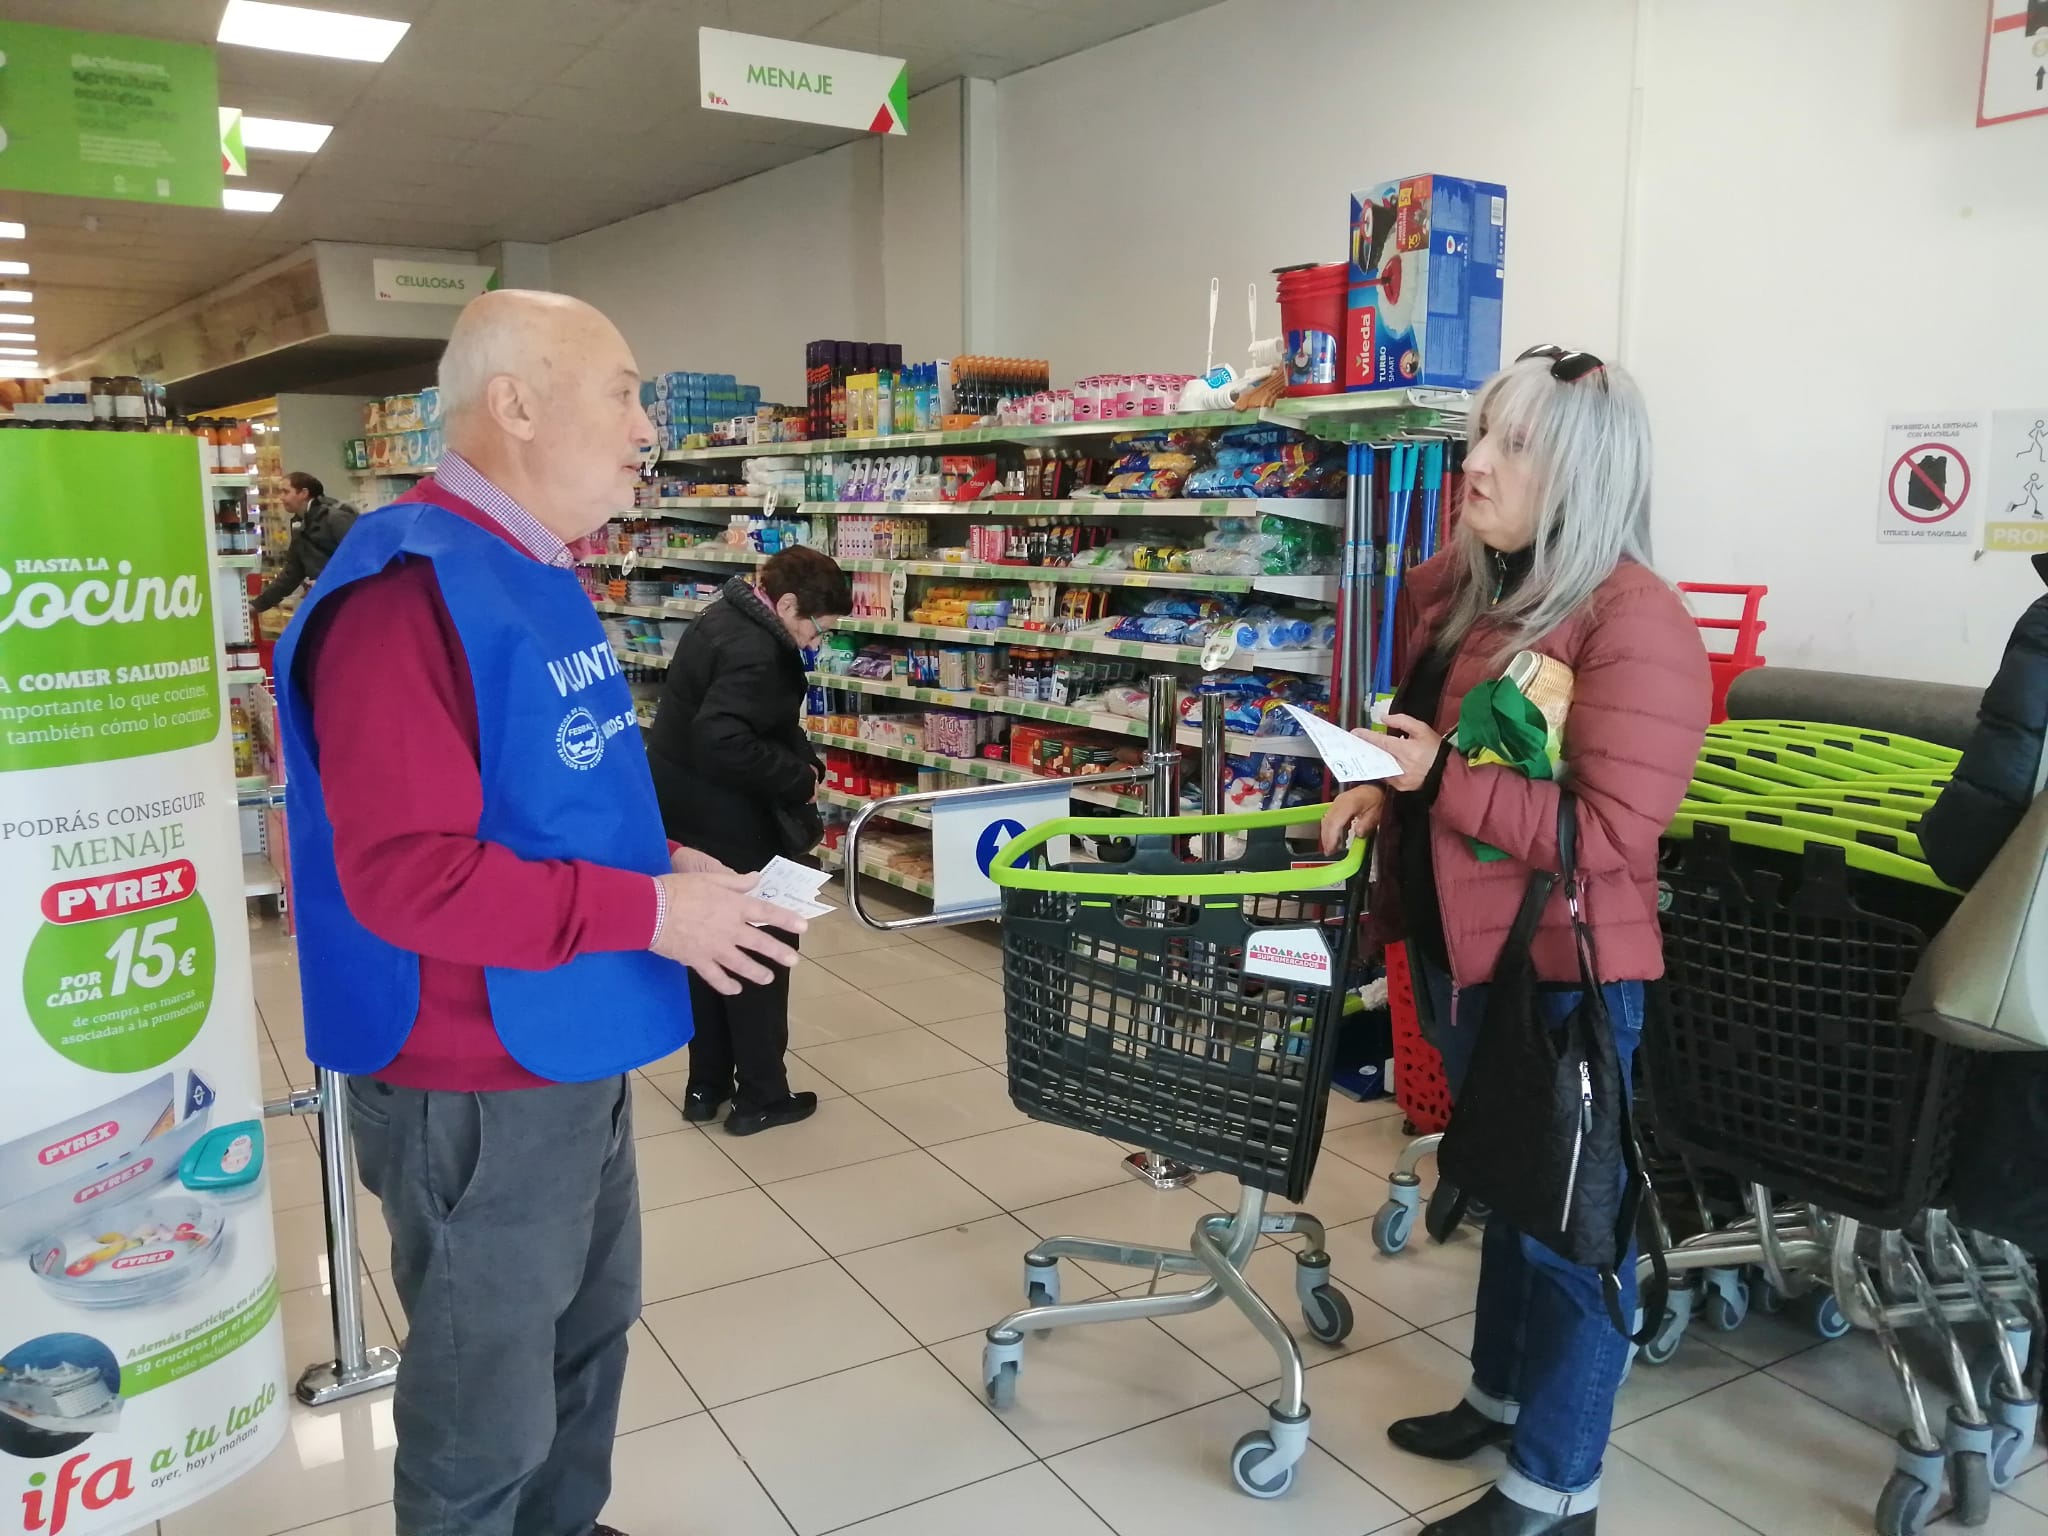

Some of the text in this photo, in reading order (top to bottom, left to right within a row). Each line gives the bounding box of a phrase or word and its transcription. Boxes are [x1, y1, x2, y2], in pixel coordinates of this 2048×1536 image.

[747, 63, 833, 96] MENAJE
[395, 275, 465, 290] CELULOSAS
[1360, 313, 1371, 377] vileda
[1379, 346, 1387, 383] TURBO
[16, 558, 109, 574] HASTA LA
[18, 668, 112, 692] COMER
[116, 656, 210, 684] SALUDABLE
[0, 697, 104, 724] mportante
[108, 693, 126, 710] lo
[130, 691, 161, 712] que
[7, 722, 94, 745] también
[100, 717, 149, 736] cómo
[153, 712, 168, 729] lo
[2, 791, 206, 840] PODRÁS CONSEGUIR
[51, 823, 186, 872] MENAJE
[57, 867, 185, 918] PYREX
[1250, 944, 1328, 963] ALTOARAGÓN
[1256, 952, 1320, 968] SUPERMERCADOS
[46, 986, 104, 1008] CADA
[60, 971, 102, 990] POR
[61, 1000, 205, 1046] asociadas a la promoción
[72, 989, 196, 1028] de compra en marcas
[45, 1125, 113, 1164] PYREX
[81, 1161, 147, 1201] PYREX
[116, 1251, 170, 1269] PYREX
[126, 1332, 182, 1360] Además
[184, 1305, 235, 1340] participa
[236, 1297, 248, 1310] en
[135, 1318, 241, 1376] 30 cruceros por el
[171, 1359, 198, 1376] todo
[199, 1336, 239, 1362] incluido
[150, 1381, 276, 1473] a tu lado
[151, 1423, 259, 1488] ayer, hoy y mañana
[22, 1453, 135, 1536] ifa
